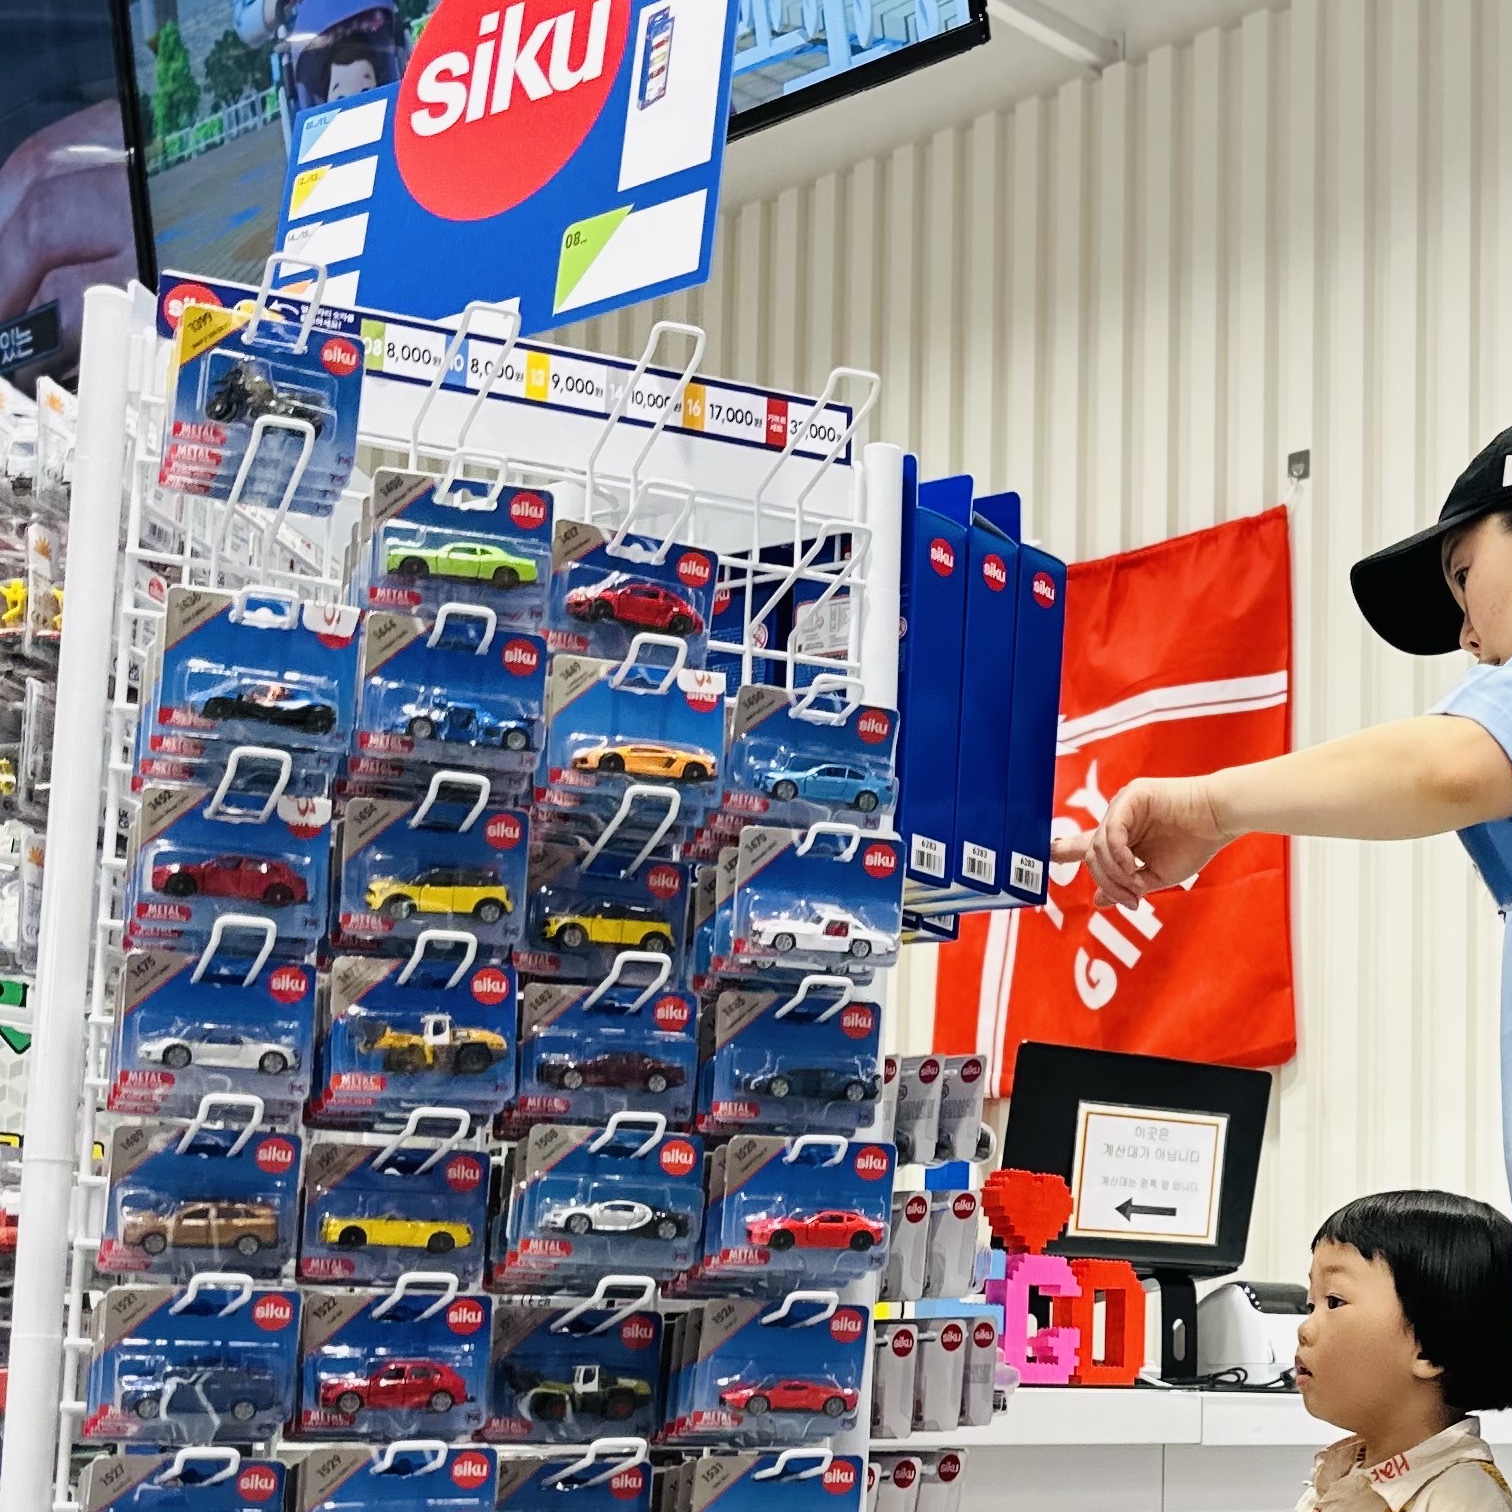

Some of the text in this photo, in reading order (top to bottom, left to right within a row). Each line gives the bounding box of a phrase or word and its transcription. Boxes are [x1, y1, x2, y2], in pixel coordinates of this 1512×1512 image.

[410, 0, 611, 138] siku
[531, 370, 544, 385] 13
[687, 399, 701, 417] 16
[512, 503, 545, 519] siku
[858, 720, 889, 736] siku
[486, 822, 520, 840] siku
[865, 853, 896, 869] siku
[271, 974, 305, 992] siku
[473, 978, 506, 996] siku
[656, 1006, 687, 1022] siku
[842, 1015, 872, 1030] siku
[1135, 1126, 1169, 1141] 이곳은
[258, 1146, 292, 1164] siku
[662, 1150, 693, 1167] siku
[1103, 1143, 1200, 1162] 계산대가 아닙니다
[857, 1156, 887, 1171] siku
[255, 1304, 290, 1320] siku
[448, 1308, 481, 1324] siku
[622, 1325, 653, 1341] siku
[831, 1317, 862, 1334] siku
[453, 1461, 487, 1478] siku
[824, 1470, 854, 1485] siku
[239, 1475, 274, 1492] siku
